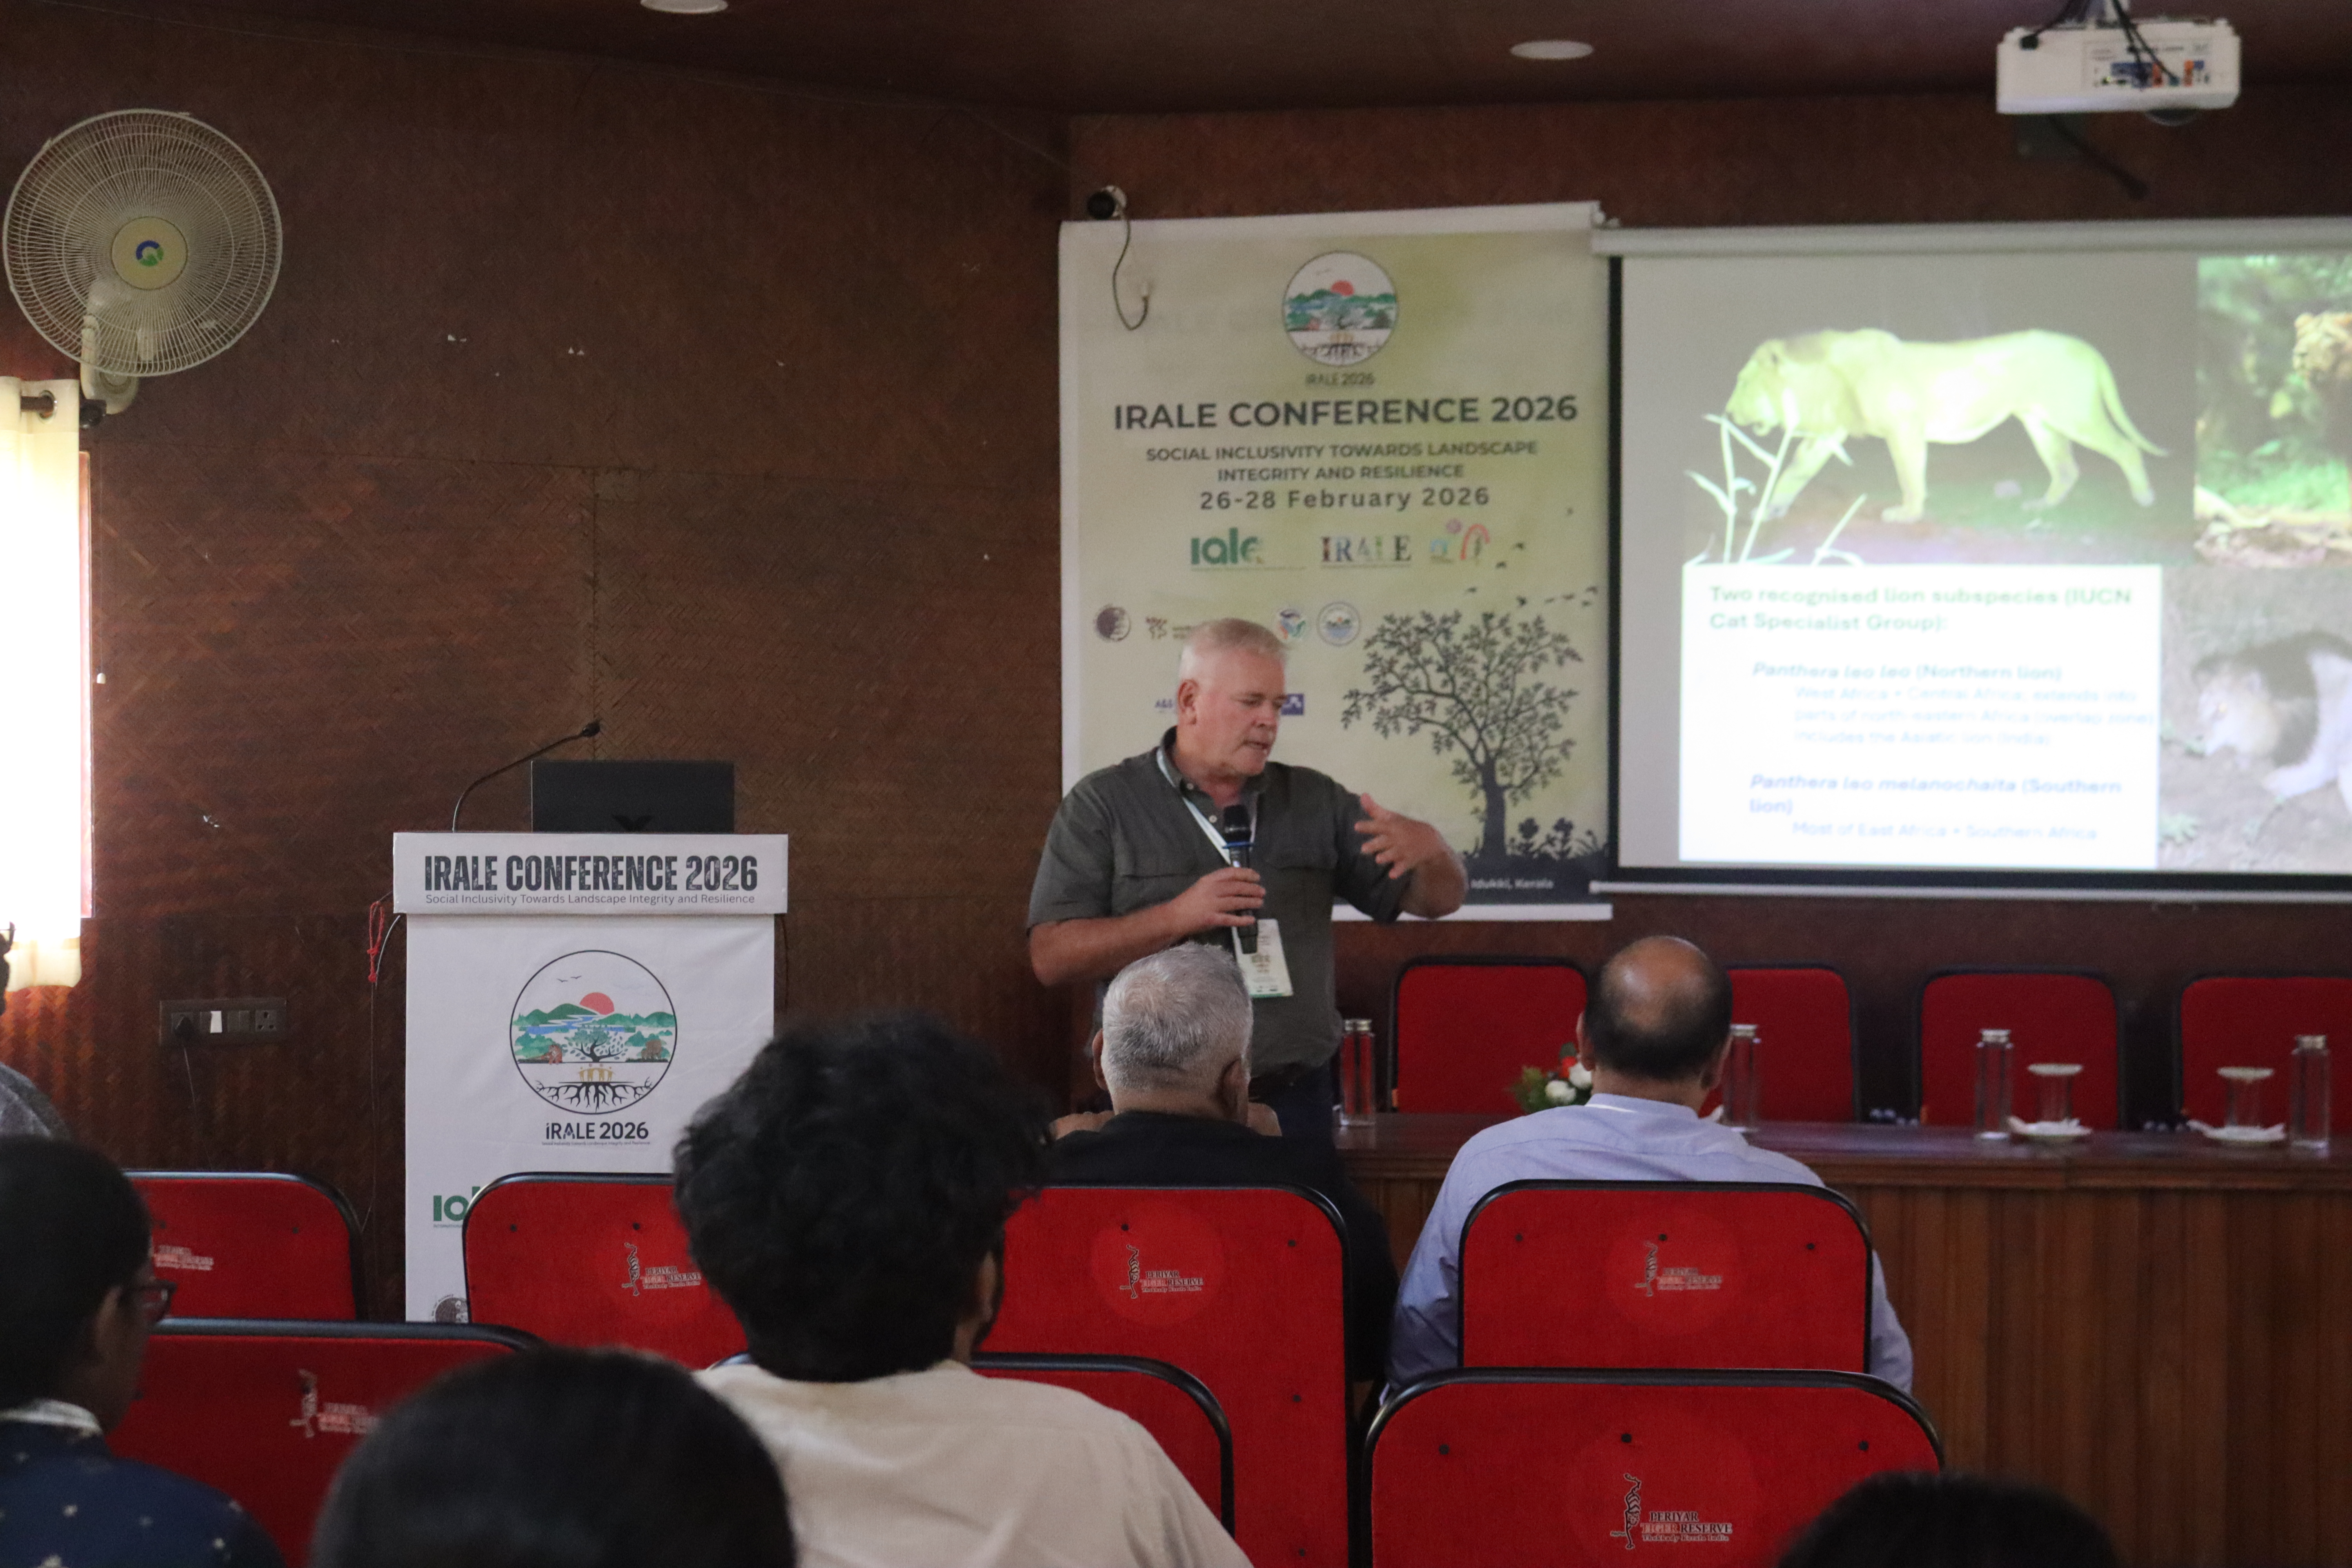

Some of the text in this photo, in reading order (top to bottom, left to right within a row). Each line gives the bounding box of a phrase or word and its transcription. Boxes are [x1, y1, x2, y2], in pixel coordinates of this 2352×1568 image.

[1115, 395, 1577, 429] IRALE CONFERENCE 2026
[1147, 441, 1537, 461] SOCIAL INCLUSIVITY TOWARDS LANDSCAPE
[1218, 465, 1464, 482] INTEGRITY AND RESILIENCE
[1200, 487, 1489, 511] 26-28 February 2026
[1710, 585, 2132, 606] Two recognised lion subspecies (IUCN
[1710, 612, 1748, 629] Cat
[1754, 612, 1860, 631] Specialist
[425, 855, 757, 891] IRALE CONFERENCE 2026
[426, 894, 755, 906] Social Inclusivity Towards Landscape Integrity and Resilience
[599, 1122, 649, 1139] 2026
[1651, 1512, 1698, 1521] PERIYAR
[1681, 1523, 1732, 1533] RESERVE
